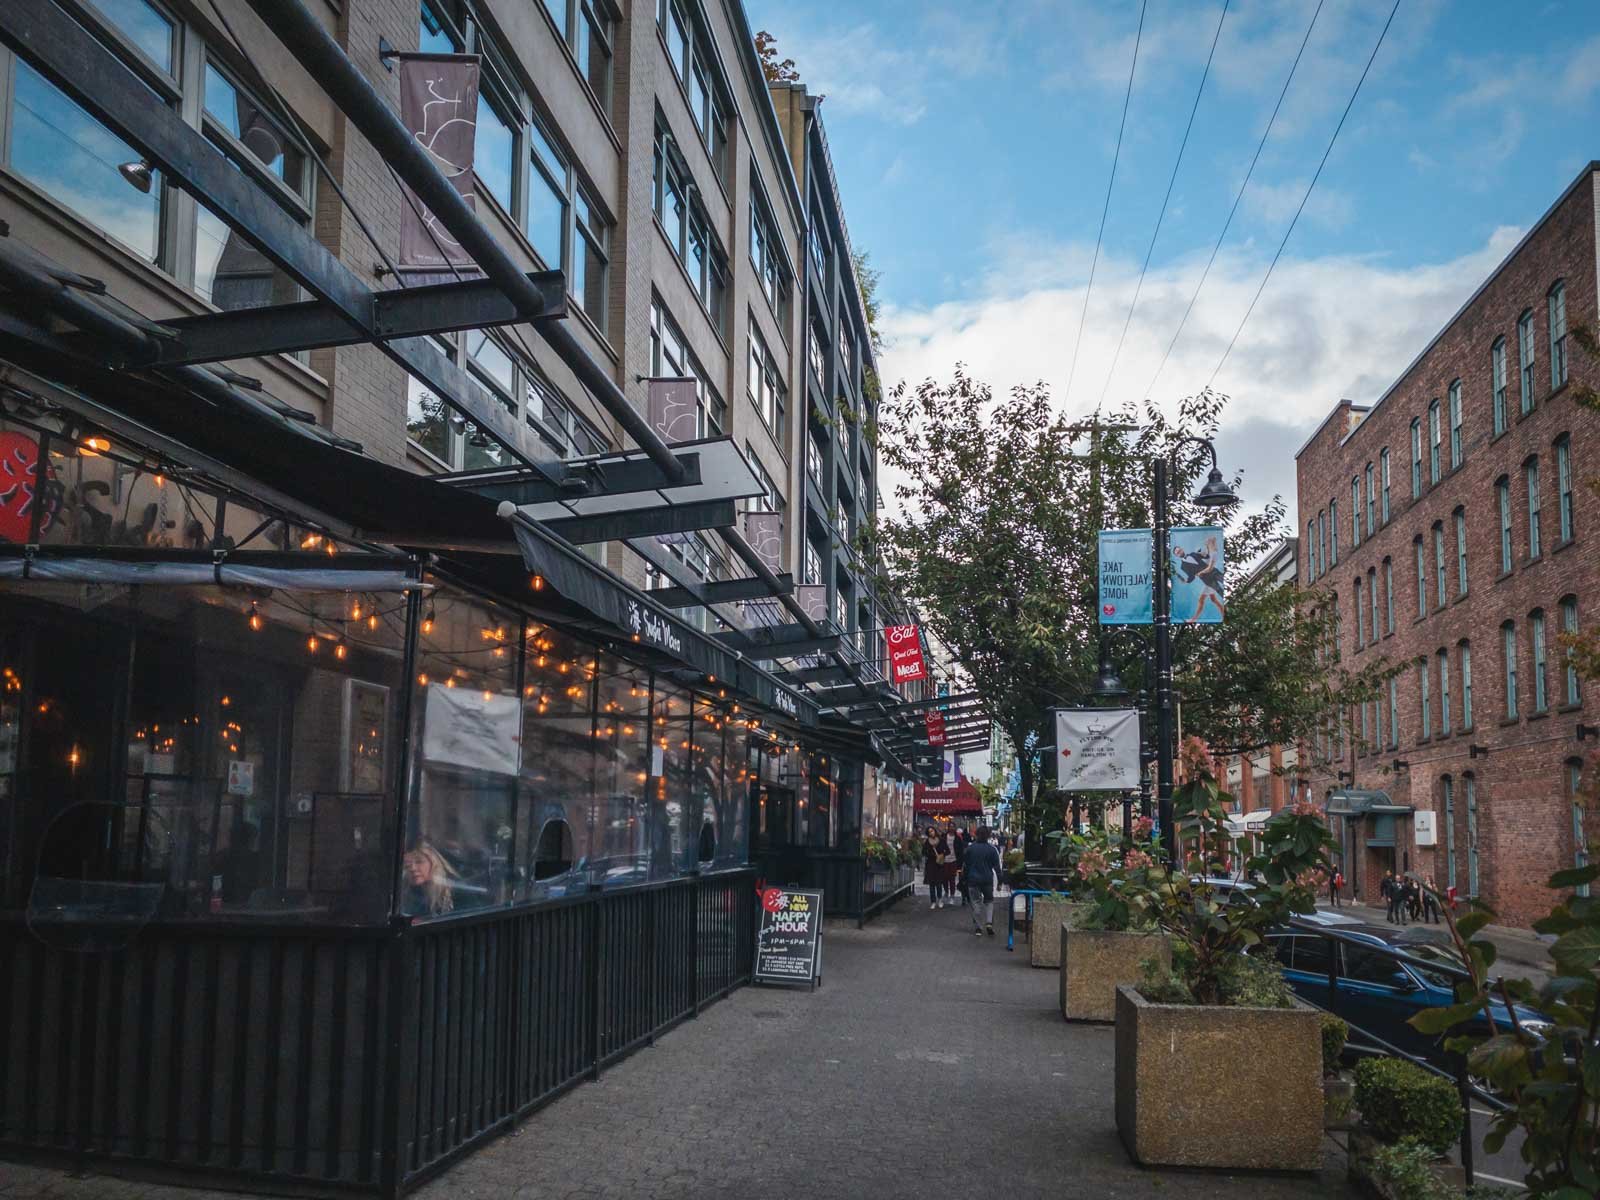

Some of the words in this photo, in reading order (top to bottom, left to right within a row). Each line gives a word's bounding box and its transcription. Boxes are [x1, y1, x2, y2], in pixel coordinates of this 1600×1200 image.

[890, 625, 914, 643] Eat
[792, 895, 807, 903] ALL
[772, 912, 811, 922] HAPPY
[775, 923, 808, 932] HOUR
